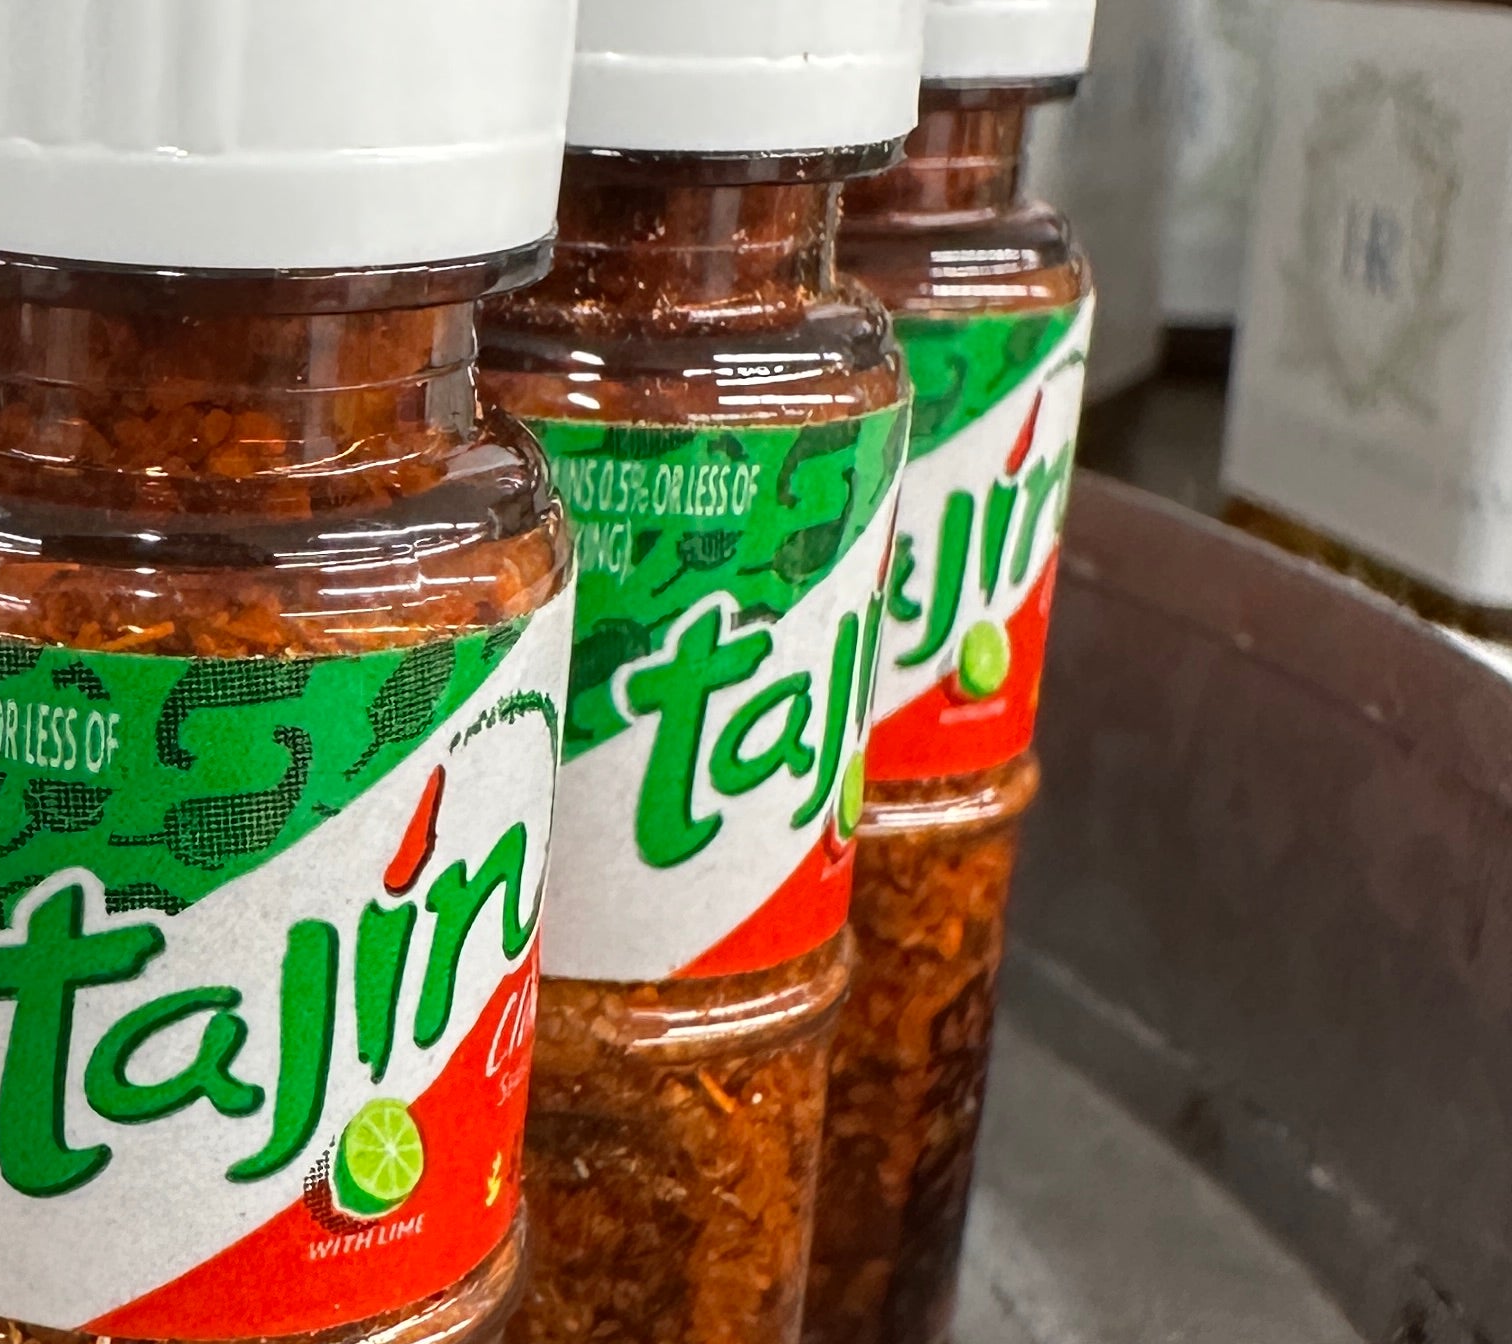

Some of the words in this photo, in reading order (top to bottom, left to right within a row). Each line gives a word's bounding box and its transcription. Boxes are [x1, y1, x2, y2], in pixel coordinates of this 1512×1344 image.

[652, 462, 685, 516] OR
[685, 464, 732, 517] LESS
[732, 463, 761, 517] OF
[23, 702, 78, 771] LESS
[85, 709, 121, 773] OF
[309, 1226, 378, 1260] WITH
[377, 1213, 425, 1245] LIME
